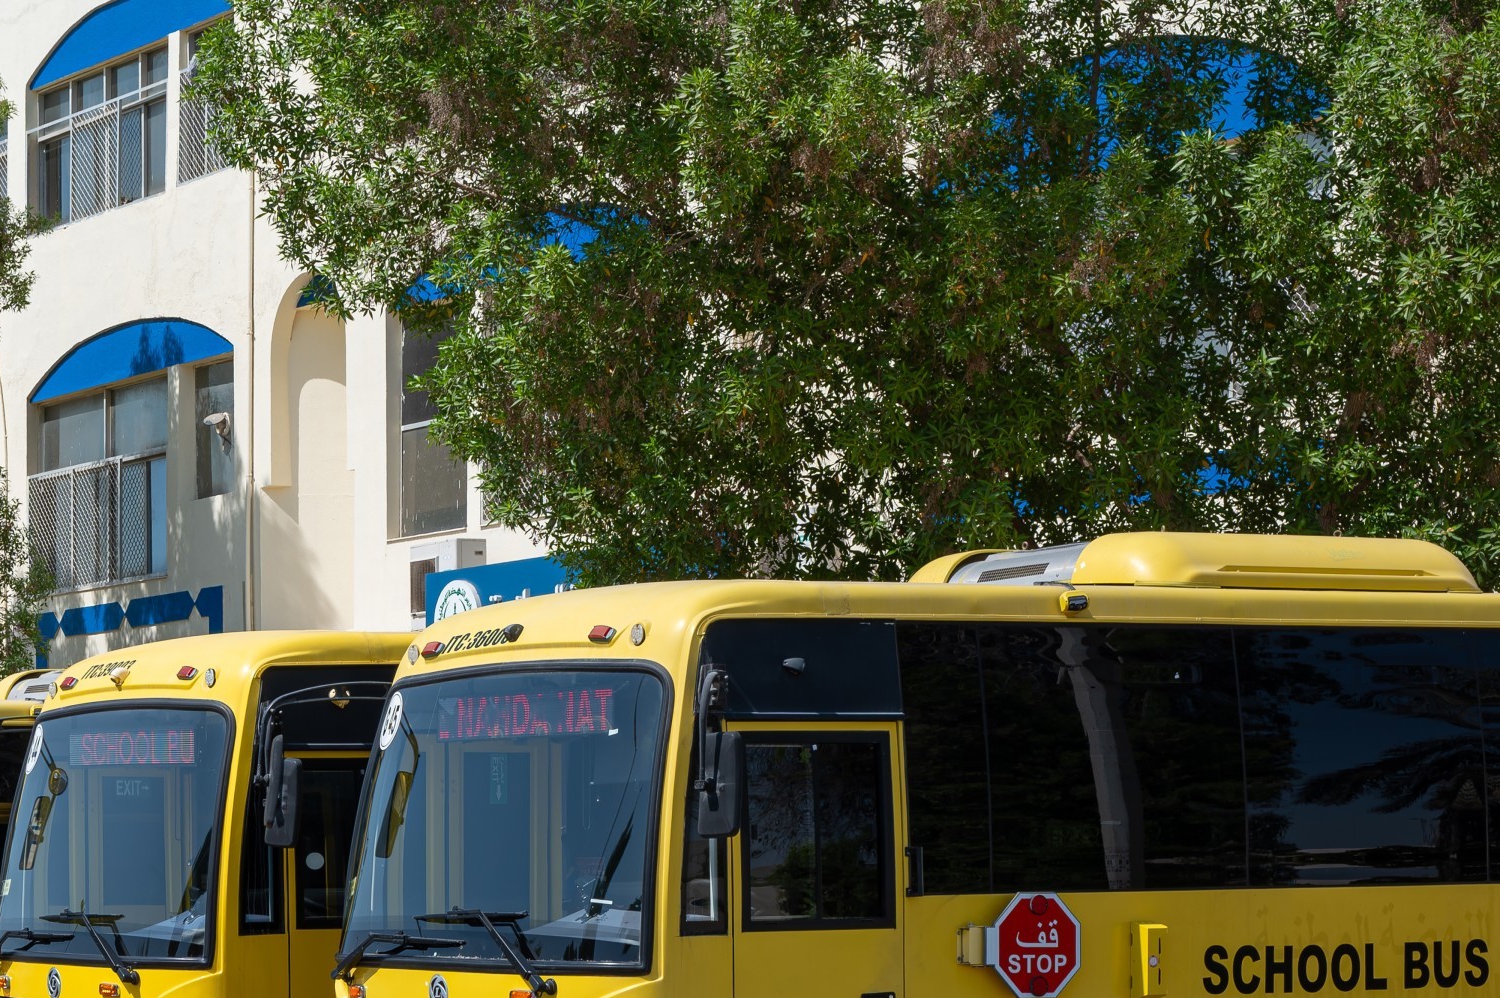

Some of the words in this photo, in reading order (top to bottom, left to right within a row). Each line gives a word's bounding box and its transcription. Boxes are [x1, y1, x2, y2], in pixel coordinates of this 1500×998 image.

[81, 730, 160, 765] SCHOOL
[116, 780, 142, 796] EXIT
[1016, 919, 1059, 948] قف
[1008, 954, 1067, 974] STOP
[1202, 942, 1388, 995] SCHOOL
[1404, 939, 1490, 989] BUS
